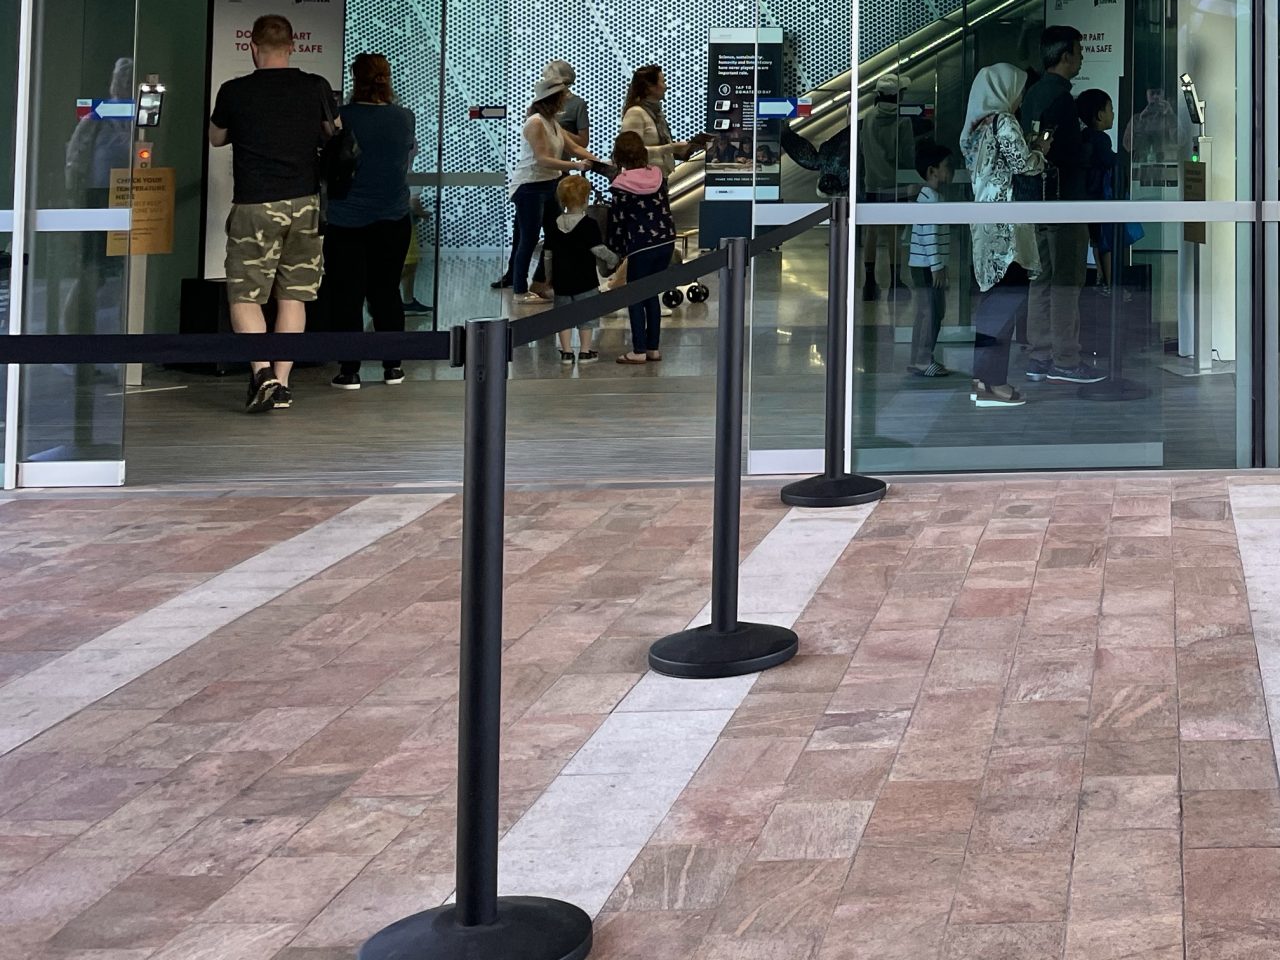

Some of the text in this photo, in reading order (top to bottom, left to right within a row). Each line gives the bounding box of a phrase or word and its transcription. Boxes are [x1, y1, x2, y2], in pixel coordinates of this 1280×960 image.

[293, 32, 312, 41] ART
[1089, 33, 1105, 41] PART
[298, 44, 323, 53] SAFE
[1096, 44, 1112, 53] SAFE
